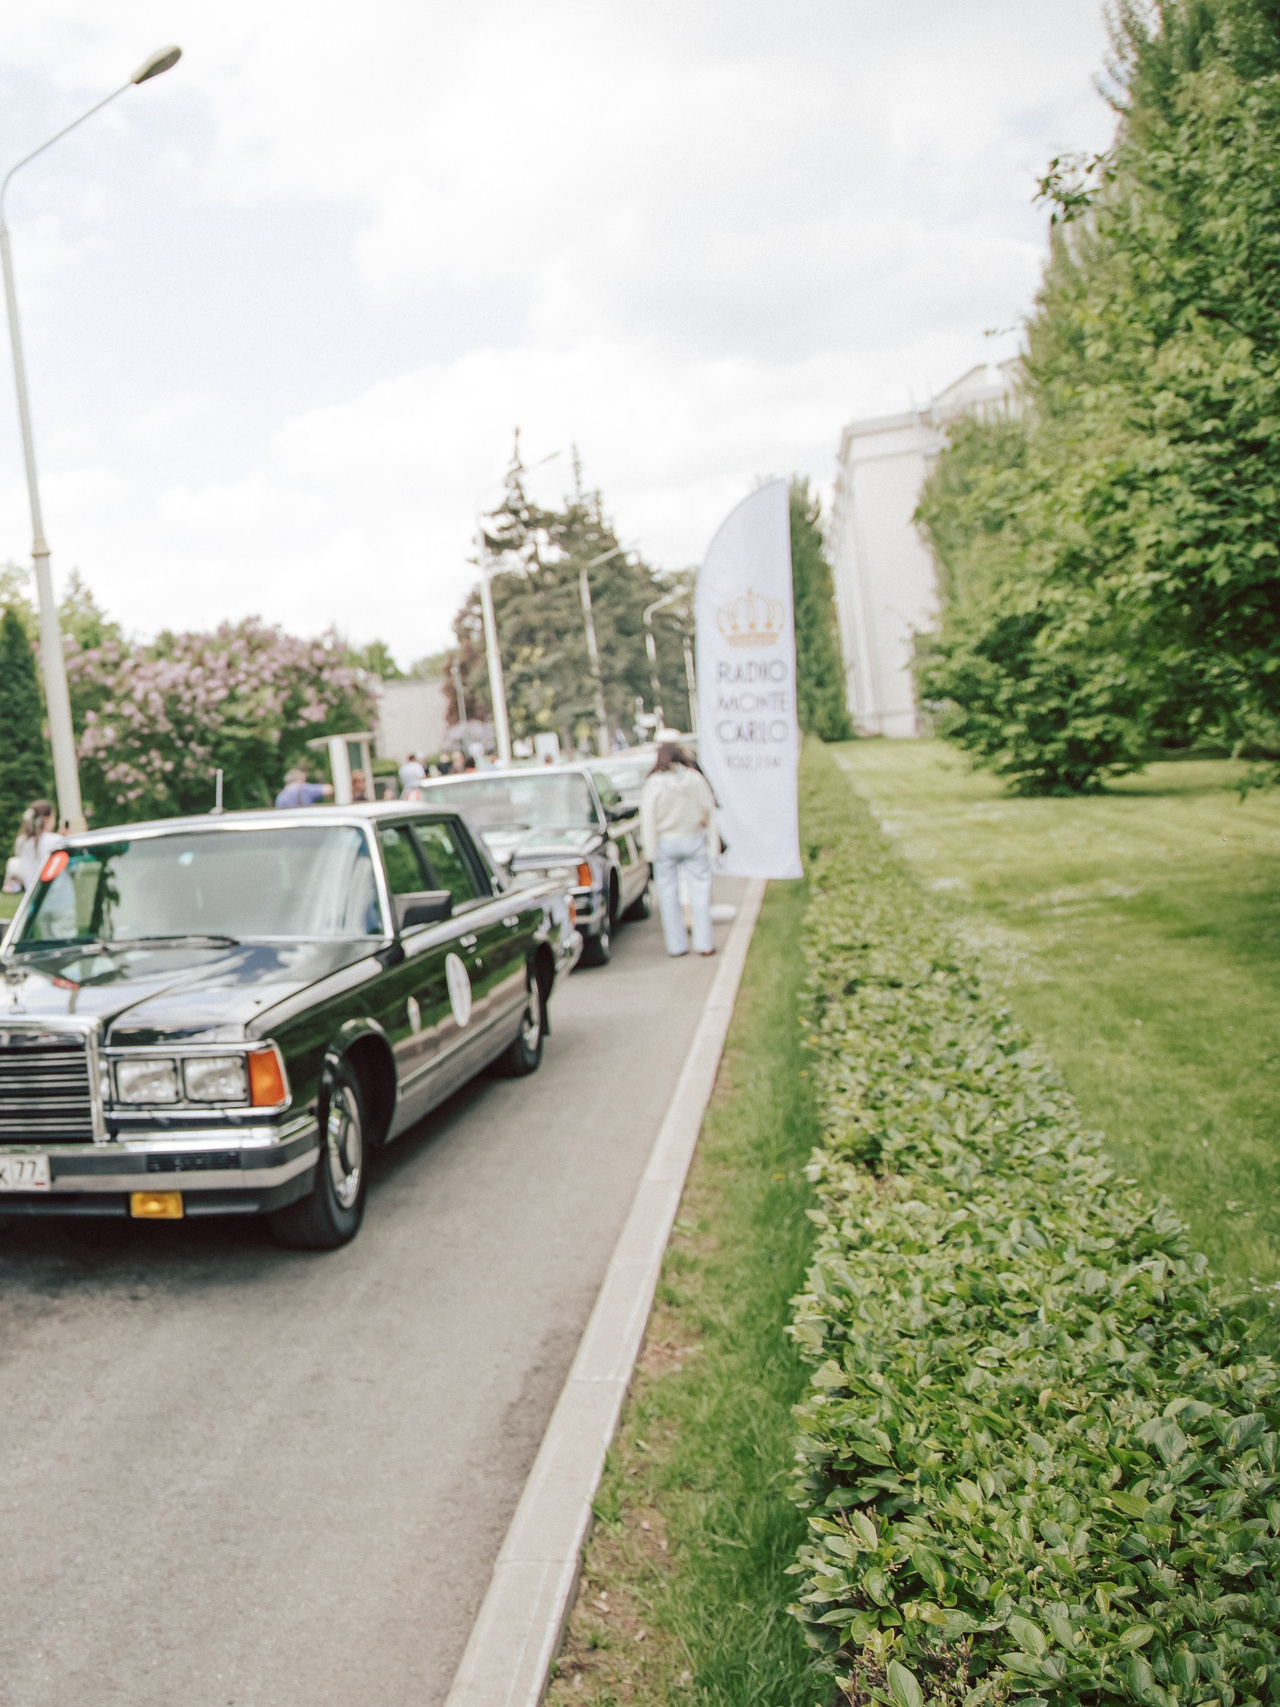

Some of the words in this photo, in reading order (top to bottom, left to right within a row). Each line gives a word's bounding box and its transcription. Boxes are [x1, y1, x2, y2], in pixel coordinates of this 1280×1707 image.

[716, 659, 788, 683] RADIO
[716, 691, 788, 713] MONTE
[715, 719, 789, 743] CARLO
